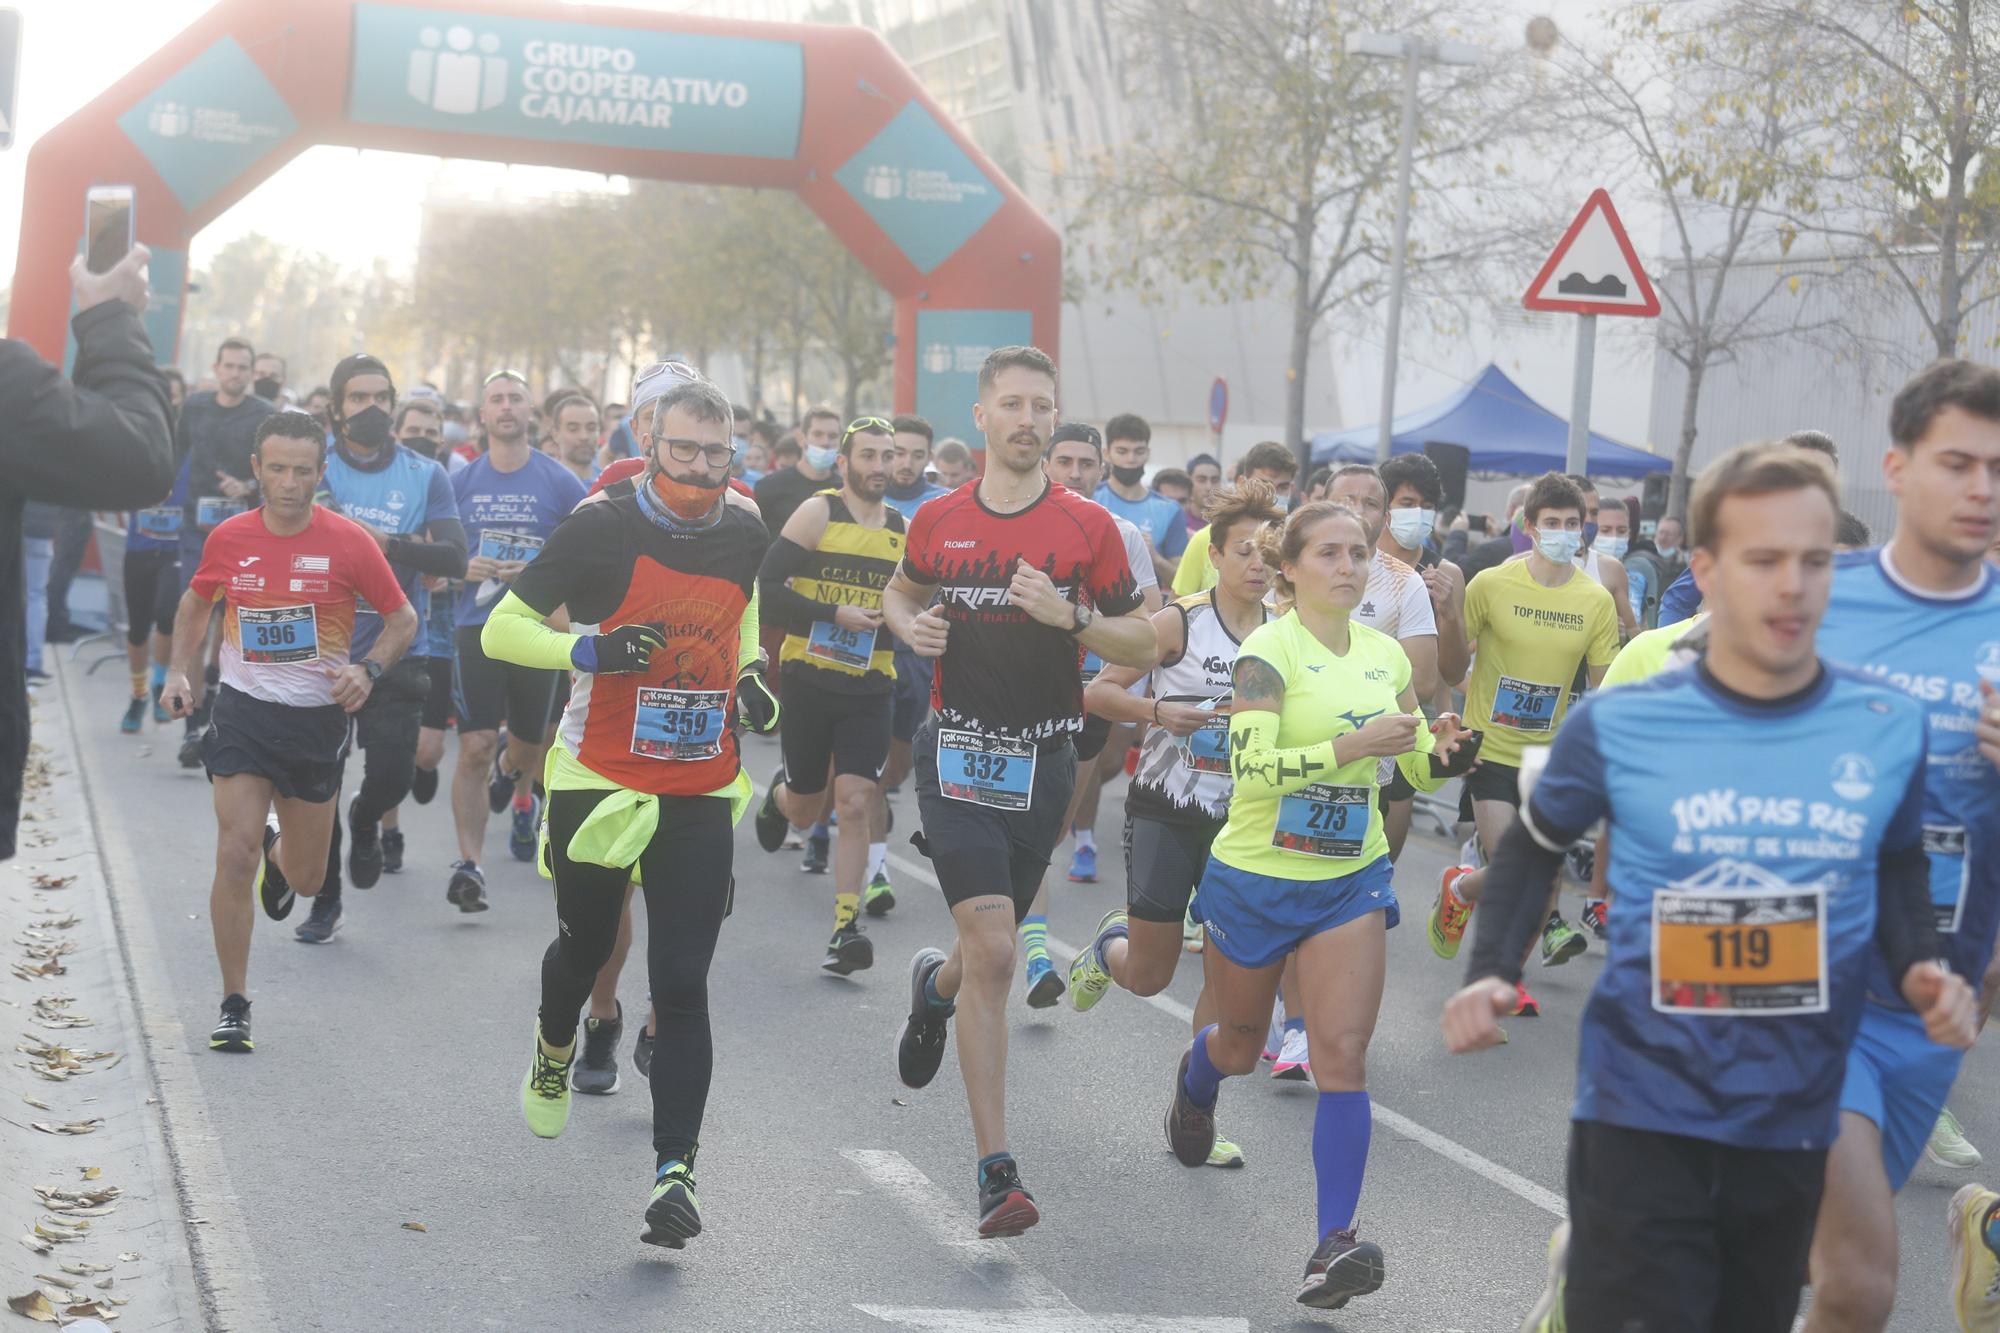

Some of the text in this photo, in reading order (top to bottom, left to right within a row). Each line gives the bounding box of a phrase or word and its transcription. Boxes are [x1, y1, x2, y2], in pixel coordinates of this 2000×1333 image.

[523, 41, 636, 73] GRUPO
[522, 66, 748, 108] COOPERATIVO
[520, 93, 673, 128] CAJAMAR
[943, 540, 977, 549] FLOWER
[1513, 605, 1585, 625] TOP RUNNERS
[1533, 619, 1584, 632] IN THE WORLD
[256, 624, 296, 647] 396
[828, 625, 859, 649] 245
[657, 693, 672, 701] PAS
[672, 695, 688, 706] RAS
[1512, 693, 1544, 714] 246
[1951, 681, 1986, 709] RA
[662, 710, 708, 737] 359
[942, 732, 984, 748] 10K PAS RAS
[1214, 730, 1231, 753] 2
[963, 752, 1008, 783] 332
[1304, 785, 1316, 793] AS
[1316, 787, 1332, 797] RAS
[1306, 802, 1348, 832] 273
[1670, 788, 1869, 841] 10K PAS RAS
[1706, 927, 1771, 970] 119
